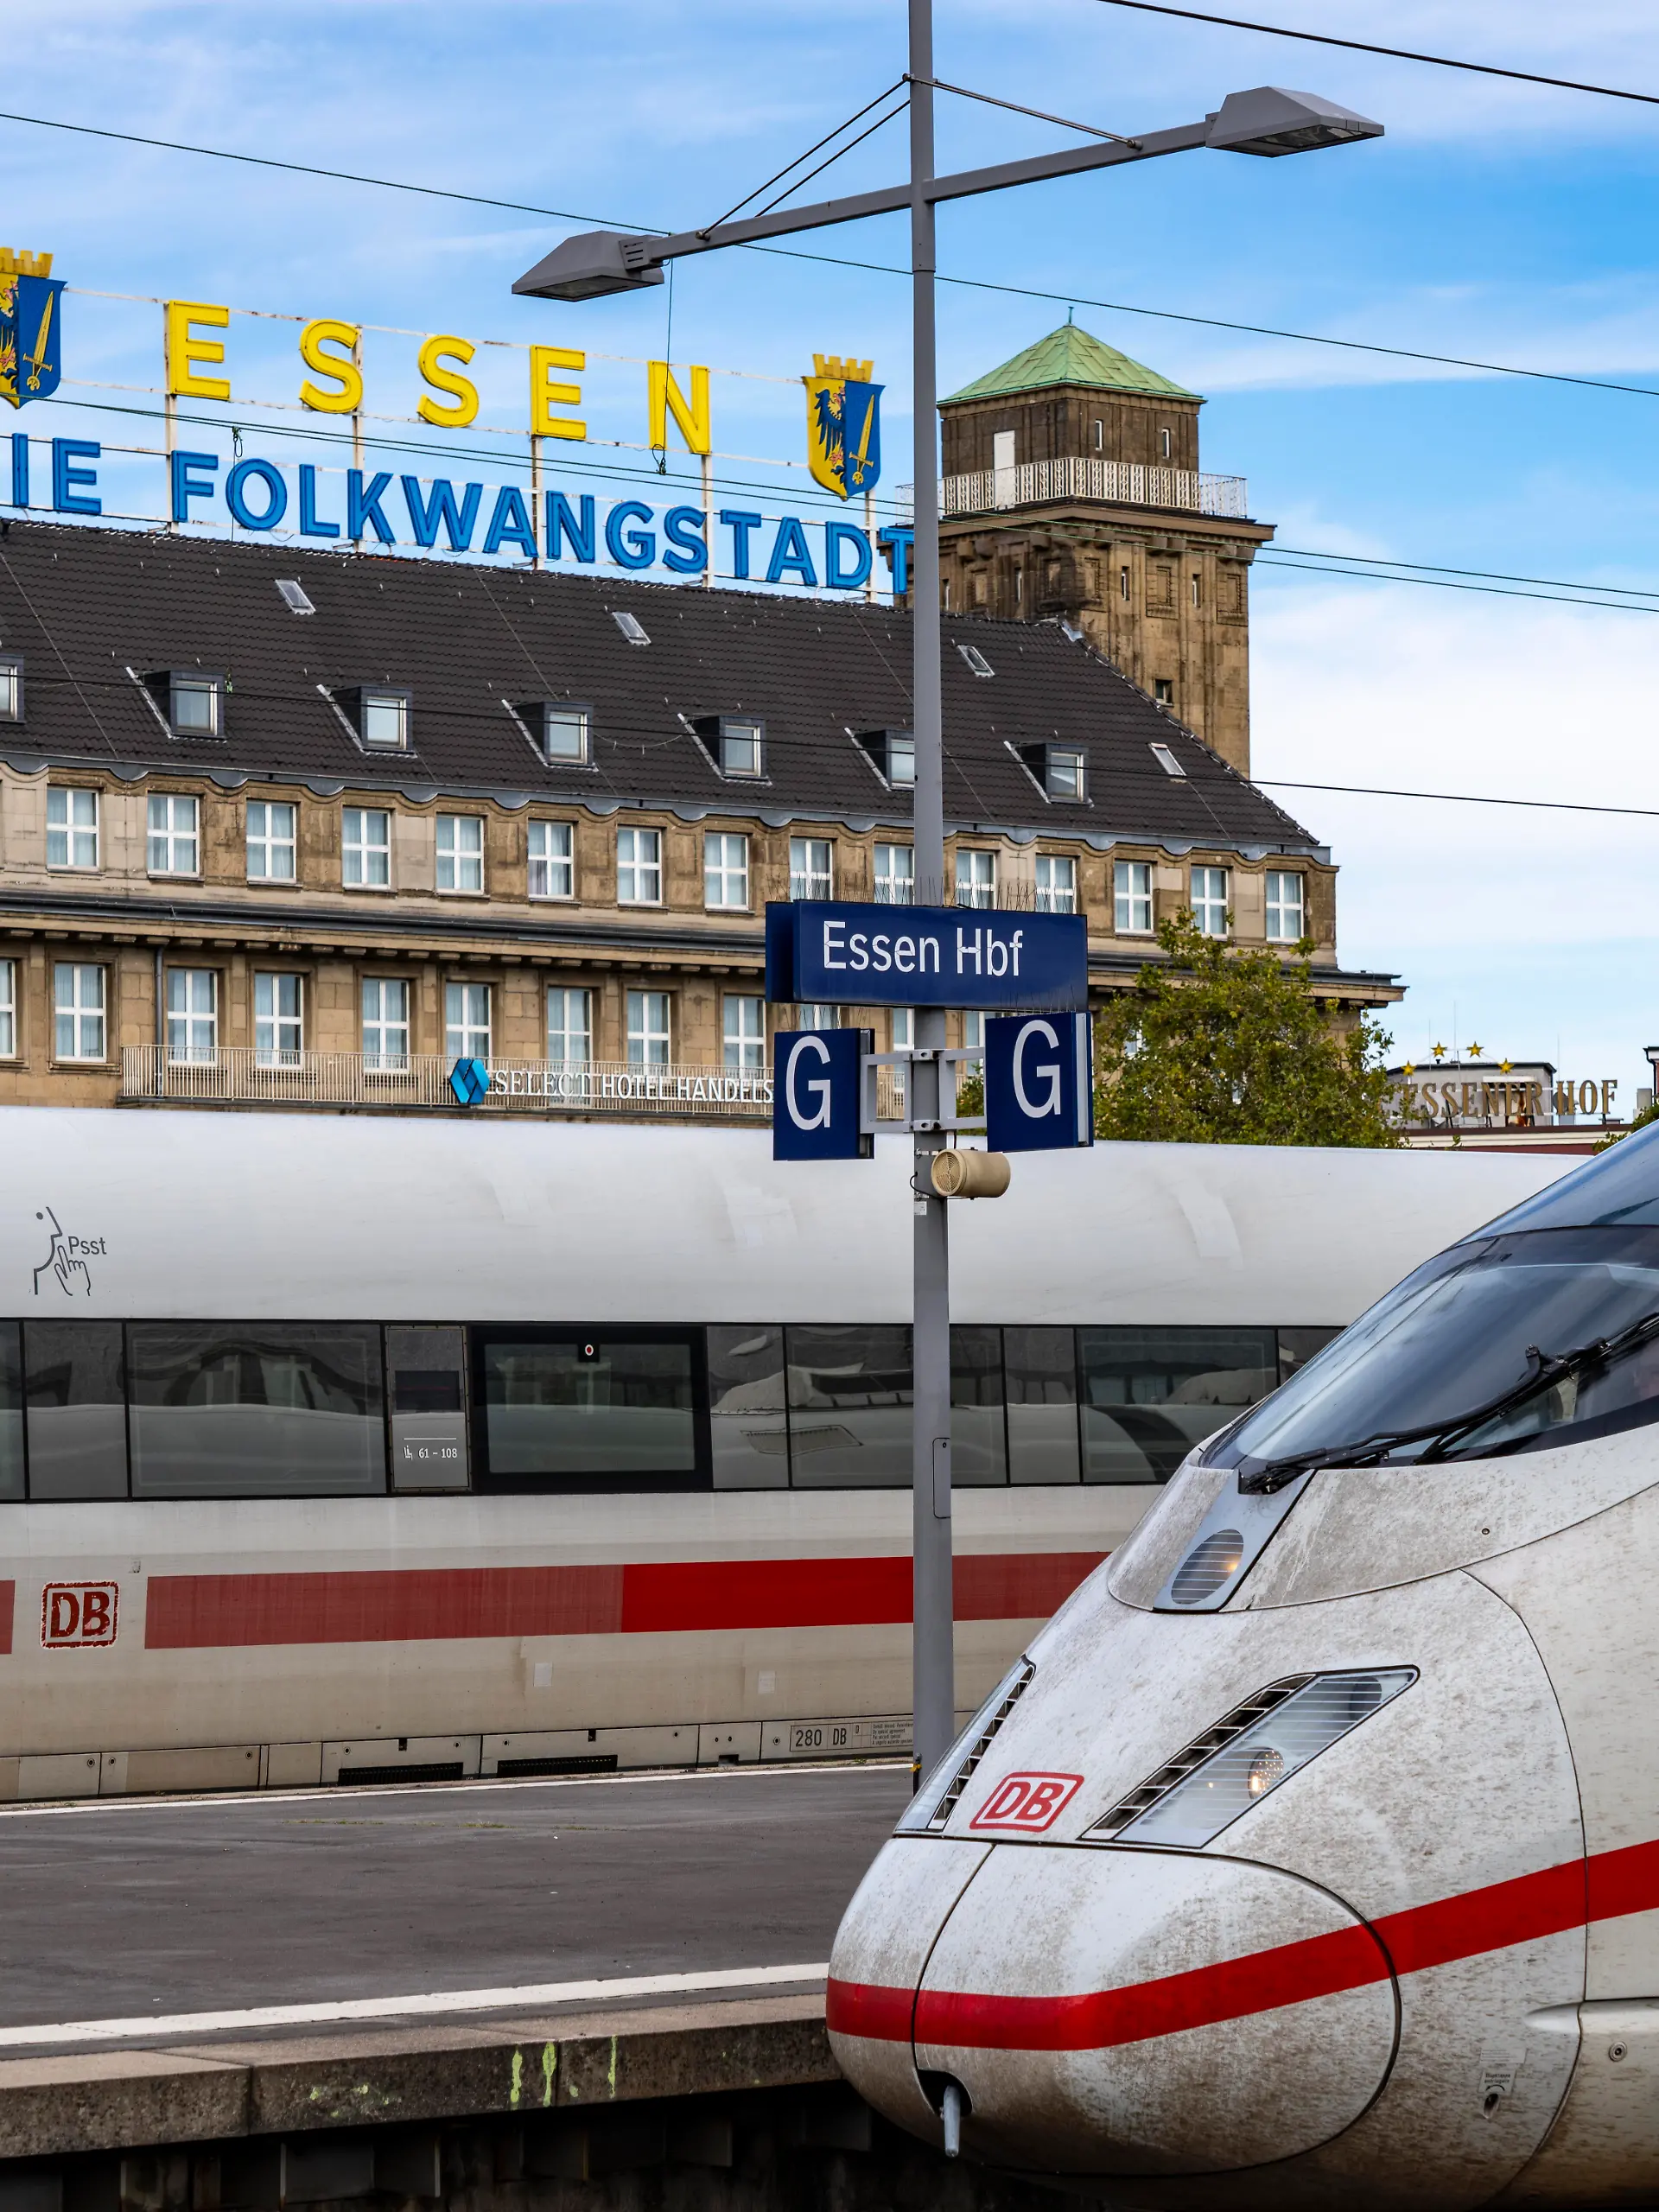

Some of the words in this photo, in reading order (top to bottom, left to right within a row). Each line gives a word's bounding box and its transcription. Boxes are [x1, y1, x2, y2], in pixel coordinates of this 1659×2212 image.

[168, 300, 711, 455] ESSEN
[172, 449, 915, 595] FOLKWANGSTADT
[823, 920, 940, 973] Essen
[957, 927, 1023, 976] Hbf
[494, 1069, 592, 1097] SELECT
[601, 1072, 672, 1101] HOTEL
[785, 1035, 832, 1131] G
[1013, 1020, 1062, 1119] G
[1556, 1079, 1618, 1116] HOF
[68, 1236, 107, 1255] Psst
[418, 1447, 429, 1459] 61
[441, 1447, 458, 1459] 108
[50, 1591, 111, 1637] DB
[796, 1729, 823, 1747] 280
[832, 1728, 847, 1745] DB
[982, 1781, 1065, 1821] DB
